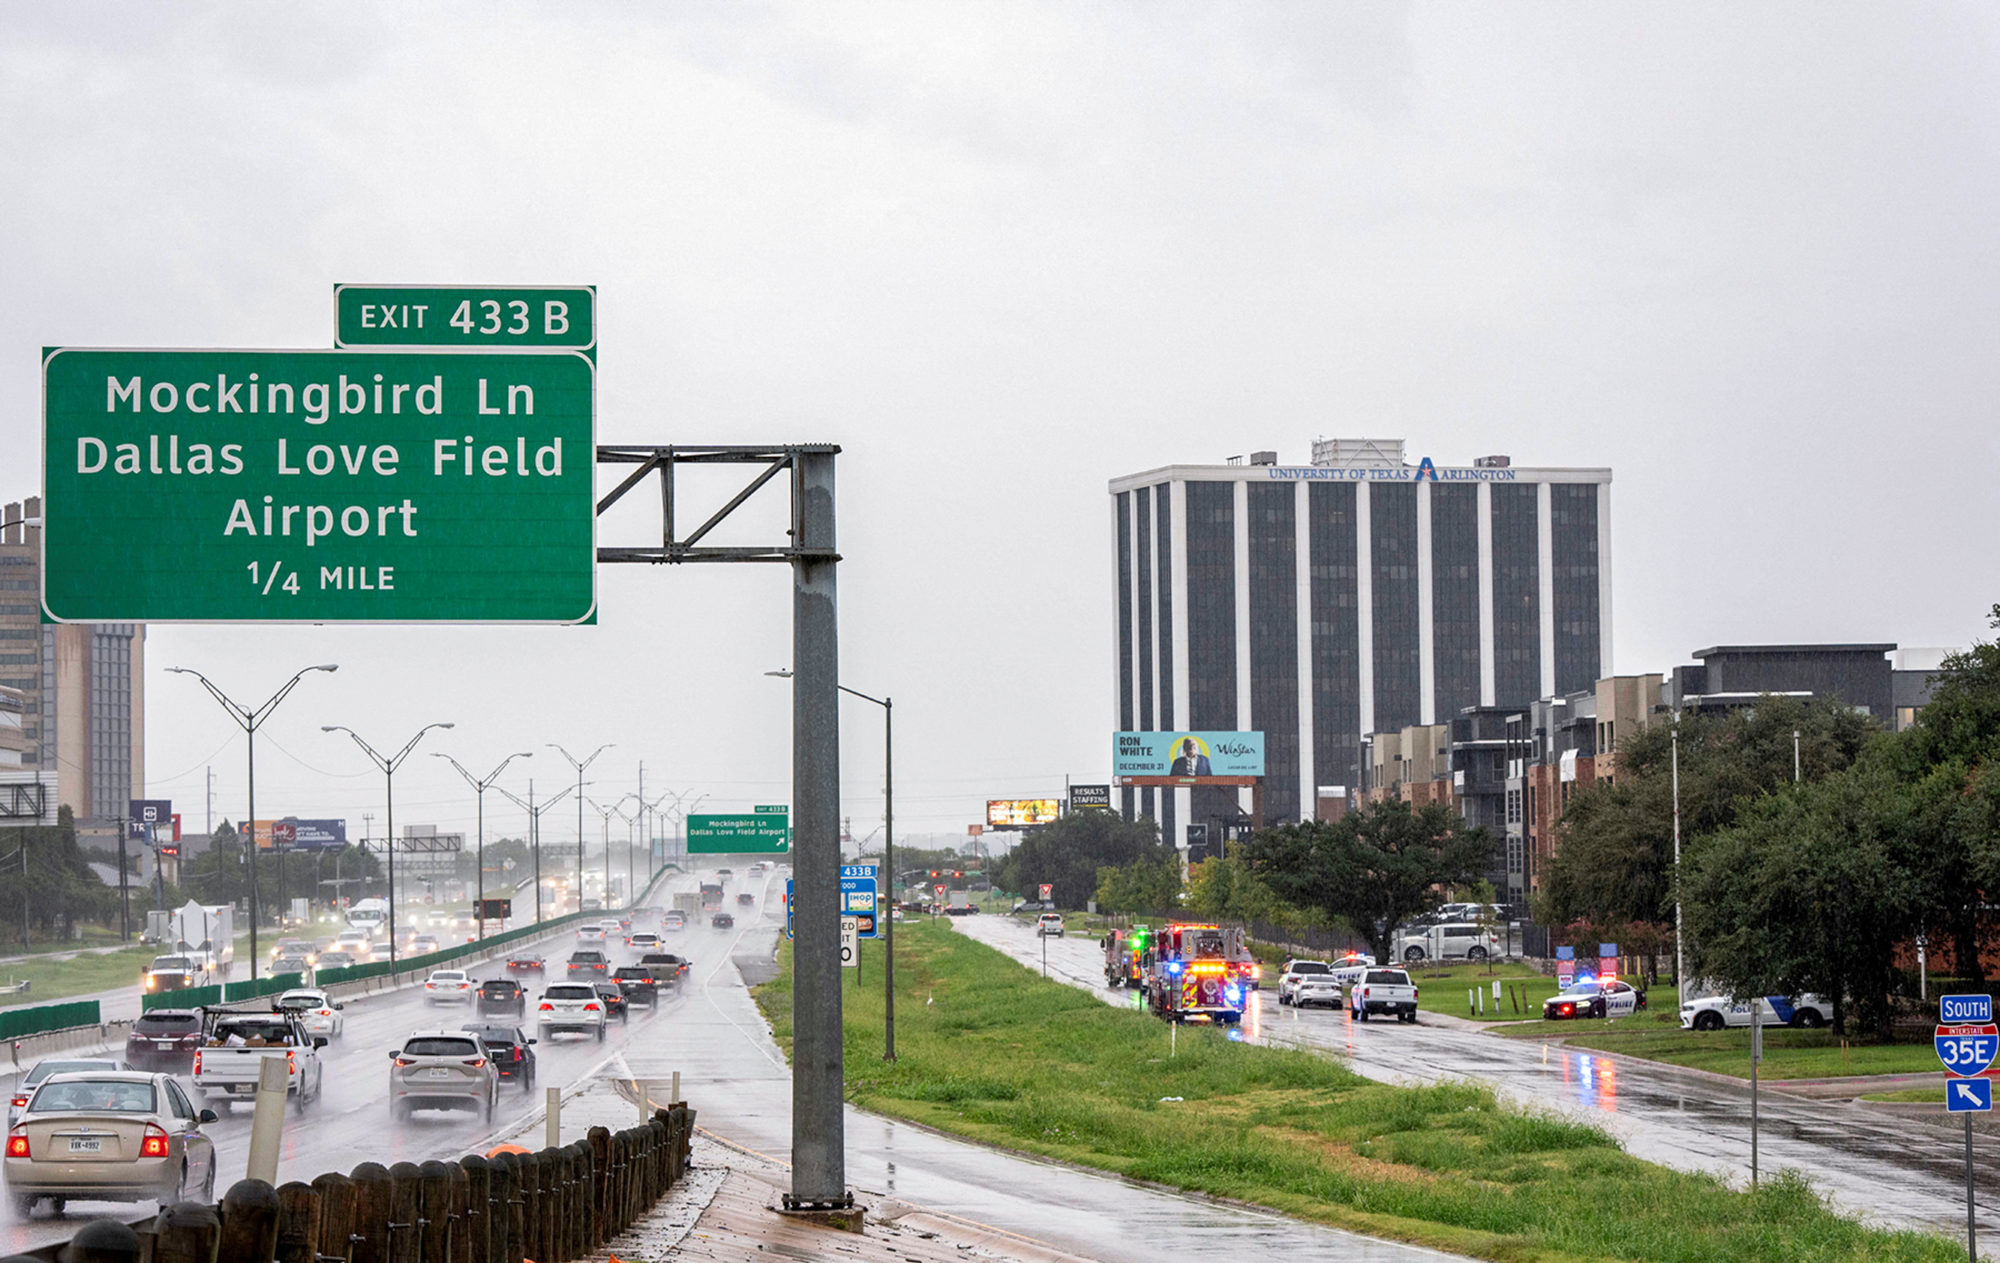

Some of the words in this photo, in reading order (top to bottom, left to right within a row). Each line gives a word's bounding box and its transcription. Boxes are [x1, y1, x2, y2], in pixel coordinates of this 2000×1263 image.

[360, 304, 429, 329] EXIT
[449, 300, 530, 335] 433
[543, 301, 570, 334] B
[106, 374, 443, 424] Mockingbird
[478, 378, 535, 416] Ln
[76, 435, 245, 475] Dallas
[277, 438, 400, 477] Love
[433, 435, 564, 477] Field
[1269, 468, 1345, 479] UNIVERSITY
[1349, 469, 1366, 479] OF
[1369, 469, 1409, 480] TEXAS
[1441, 469, 1516, 481] ARLINGTON
[223, 495, 418, 547] Airport
[247, 561, 301, 596] 1/4
[319, 566, 395, 590] MILE
[1119, 736, 1141, 746] RON
[1119, 747, 1153, 756] WHITE
[709, 820, 755, 828] Mockingbird
[844, 867, 872, 876] 433B
[1730, 1006, 1751, 1014] POLI
[1944, 1000, 1988, 1018] SOUTH
[1943, 1040, 1990, 1065] 35E
